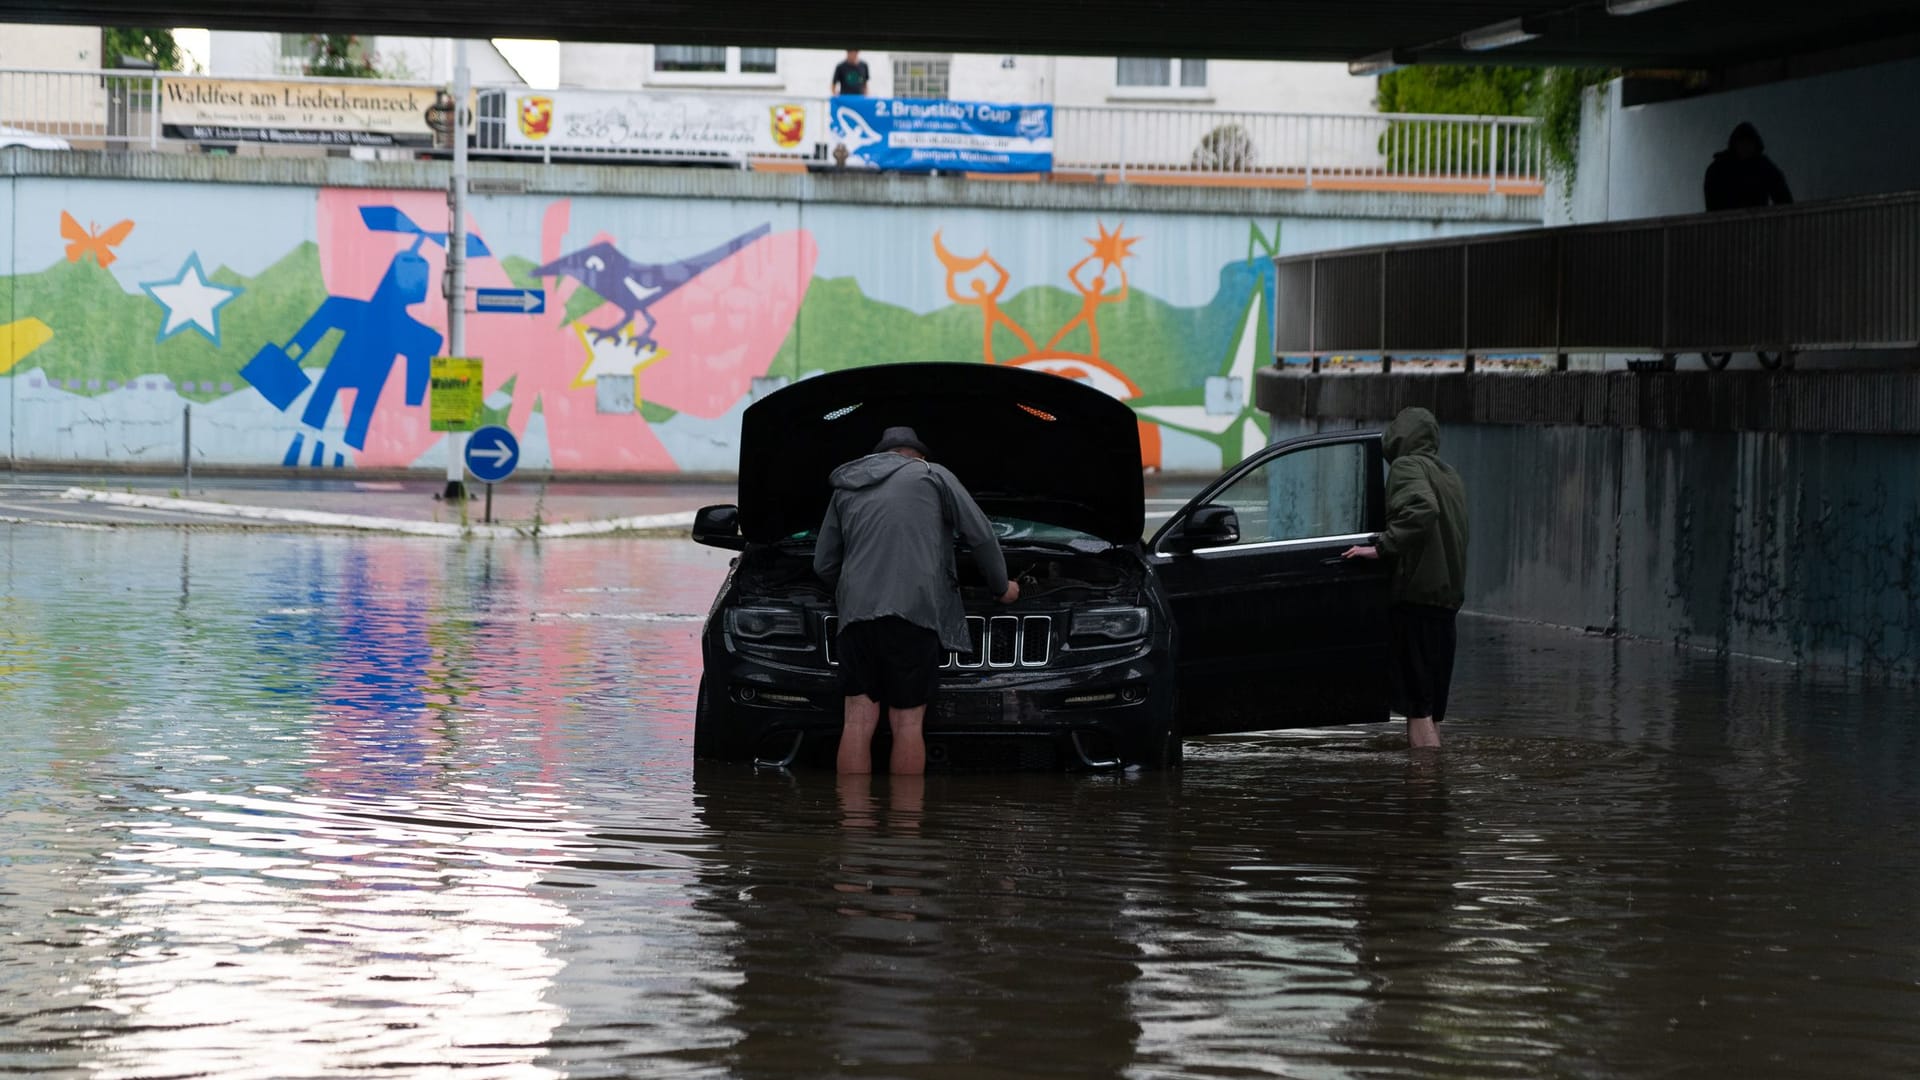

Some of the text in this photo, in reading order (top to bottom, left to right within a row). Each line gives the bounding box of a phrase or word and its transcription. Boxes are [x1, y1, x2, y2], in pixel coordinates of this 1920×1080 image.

[167, 83, 419, 111] Waldfest am Liederkranzeck
[875, 102, 890, 117] 2.
[977, 106, 1011, 123] Cup
[1247, 218, 1281, 266] N
